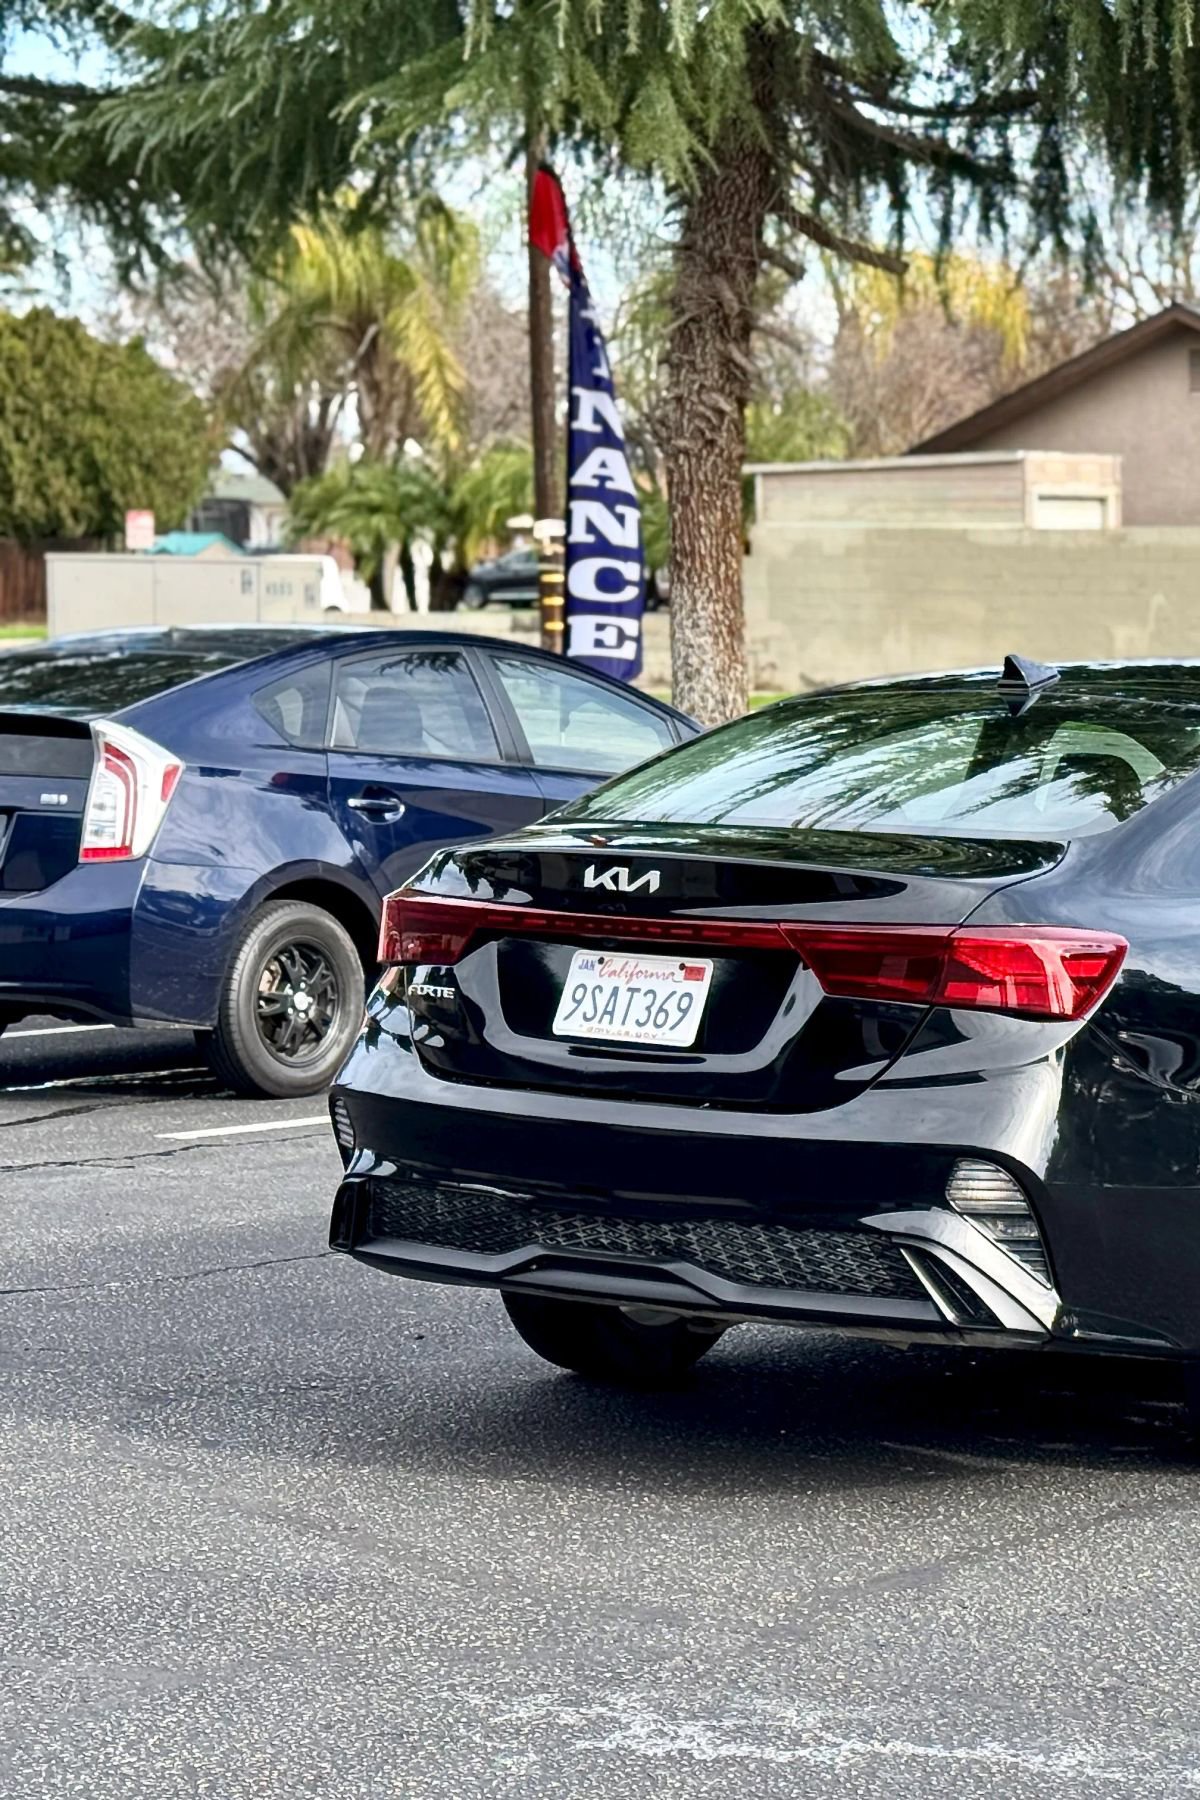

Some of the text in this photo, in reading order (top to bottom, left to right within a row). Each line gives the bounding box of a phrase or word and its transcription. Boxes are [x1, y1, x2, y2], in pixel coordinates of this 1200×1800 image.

[583, 864, 661, 894] KIA
[578, 958, 597, 971] JAN
[599, 958, 683, 985] California
[408, 984, 456, 999] FORTE
[563, 983, 694, 1031] 9SAT369
